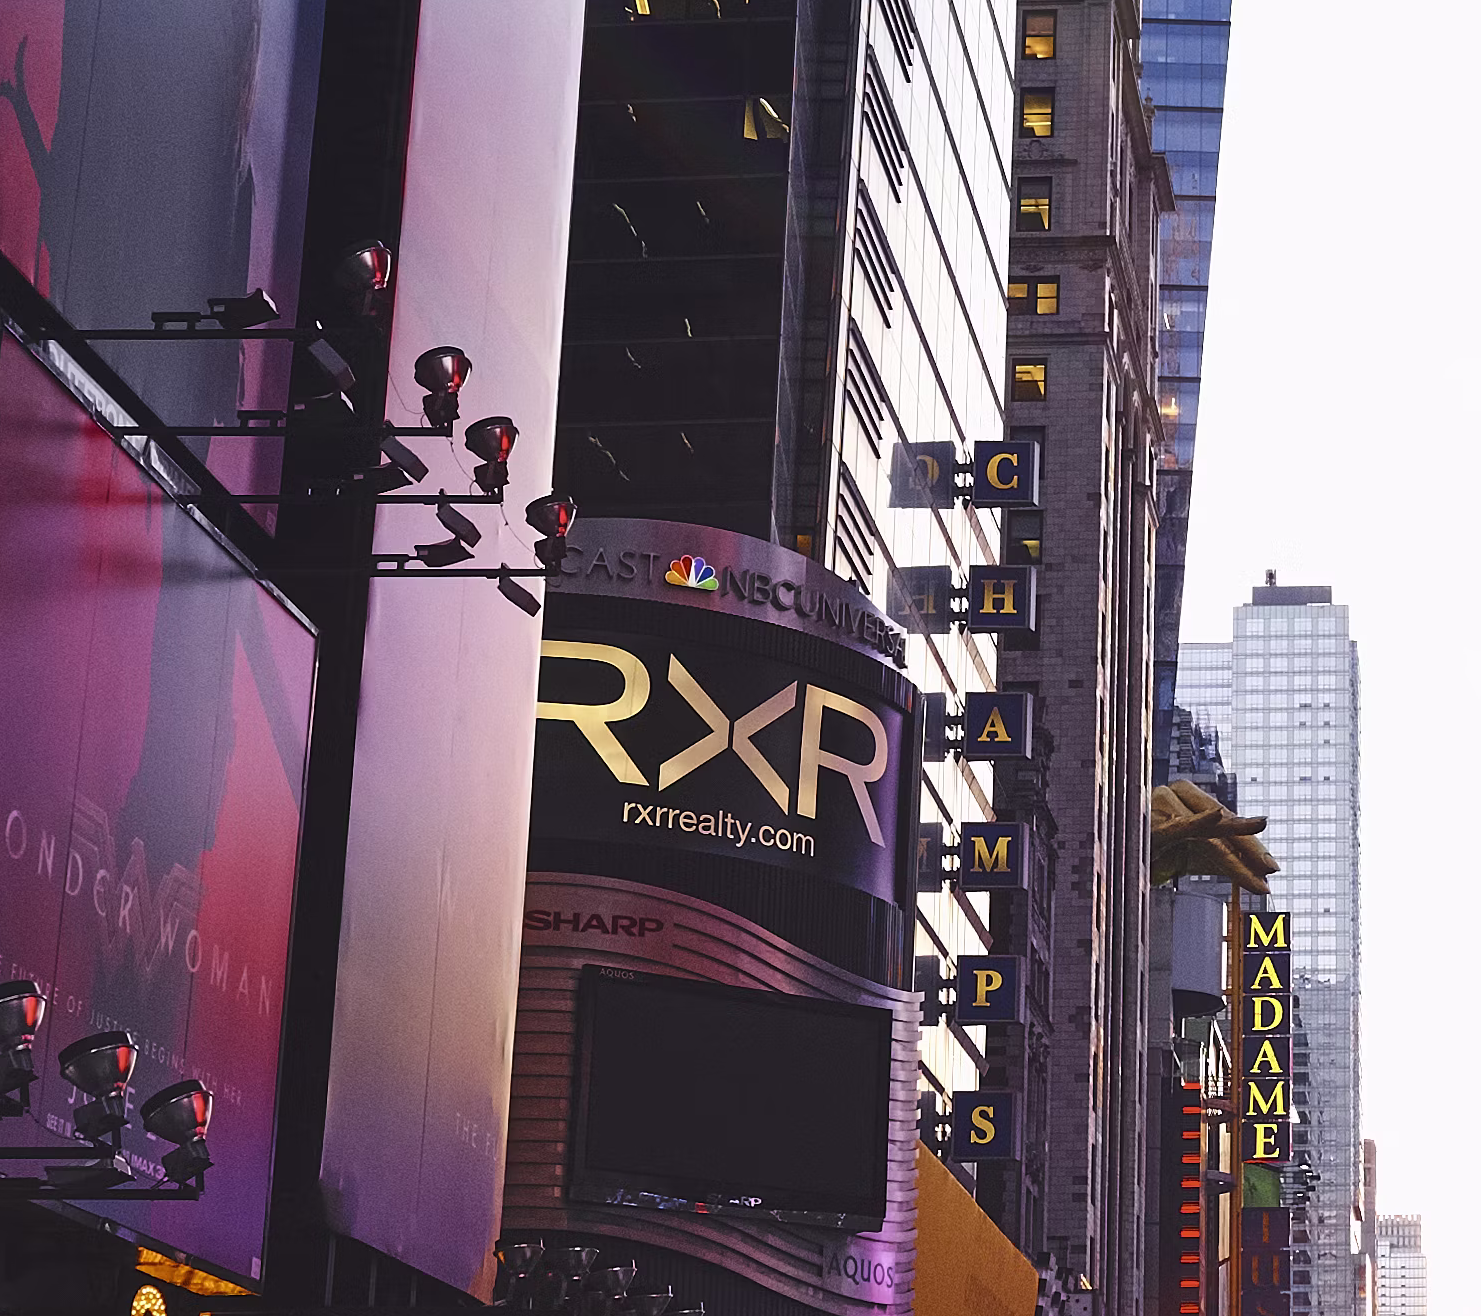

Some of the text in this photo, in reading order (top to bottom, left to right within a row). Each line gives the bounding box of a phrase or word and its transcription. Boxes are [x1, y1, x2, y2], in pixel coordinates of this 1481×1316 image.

[536, 639, 889, 849] RXR
[622, 800, 815, 858] rxrrealty.com
[969, 452, 1019, 1147] CHAMPS
[524, 909, 664, 938] SHARP
[160, 916, 273, 1017] WOMAN
[599, 967, 635, 980] AQUOS
[67, 995, 83, 1017] OF
[144, 1034, 185, 1074] BEGINS
[1246, 913, 1288, 1160] MADAME
[827, 1256, 893, 1289] AQUOS
